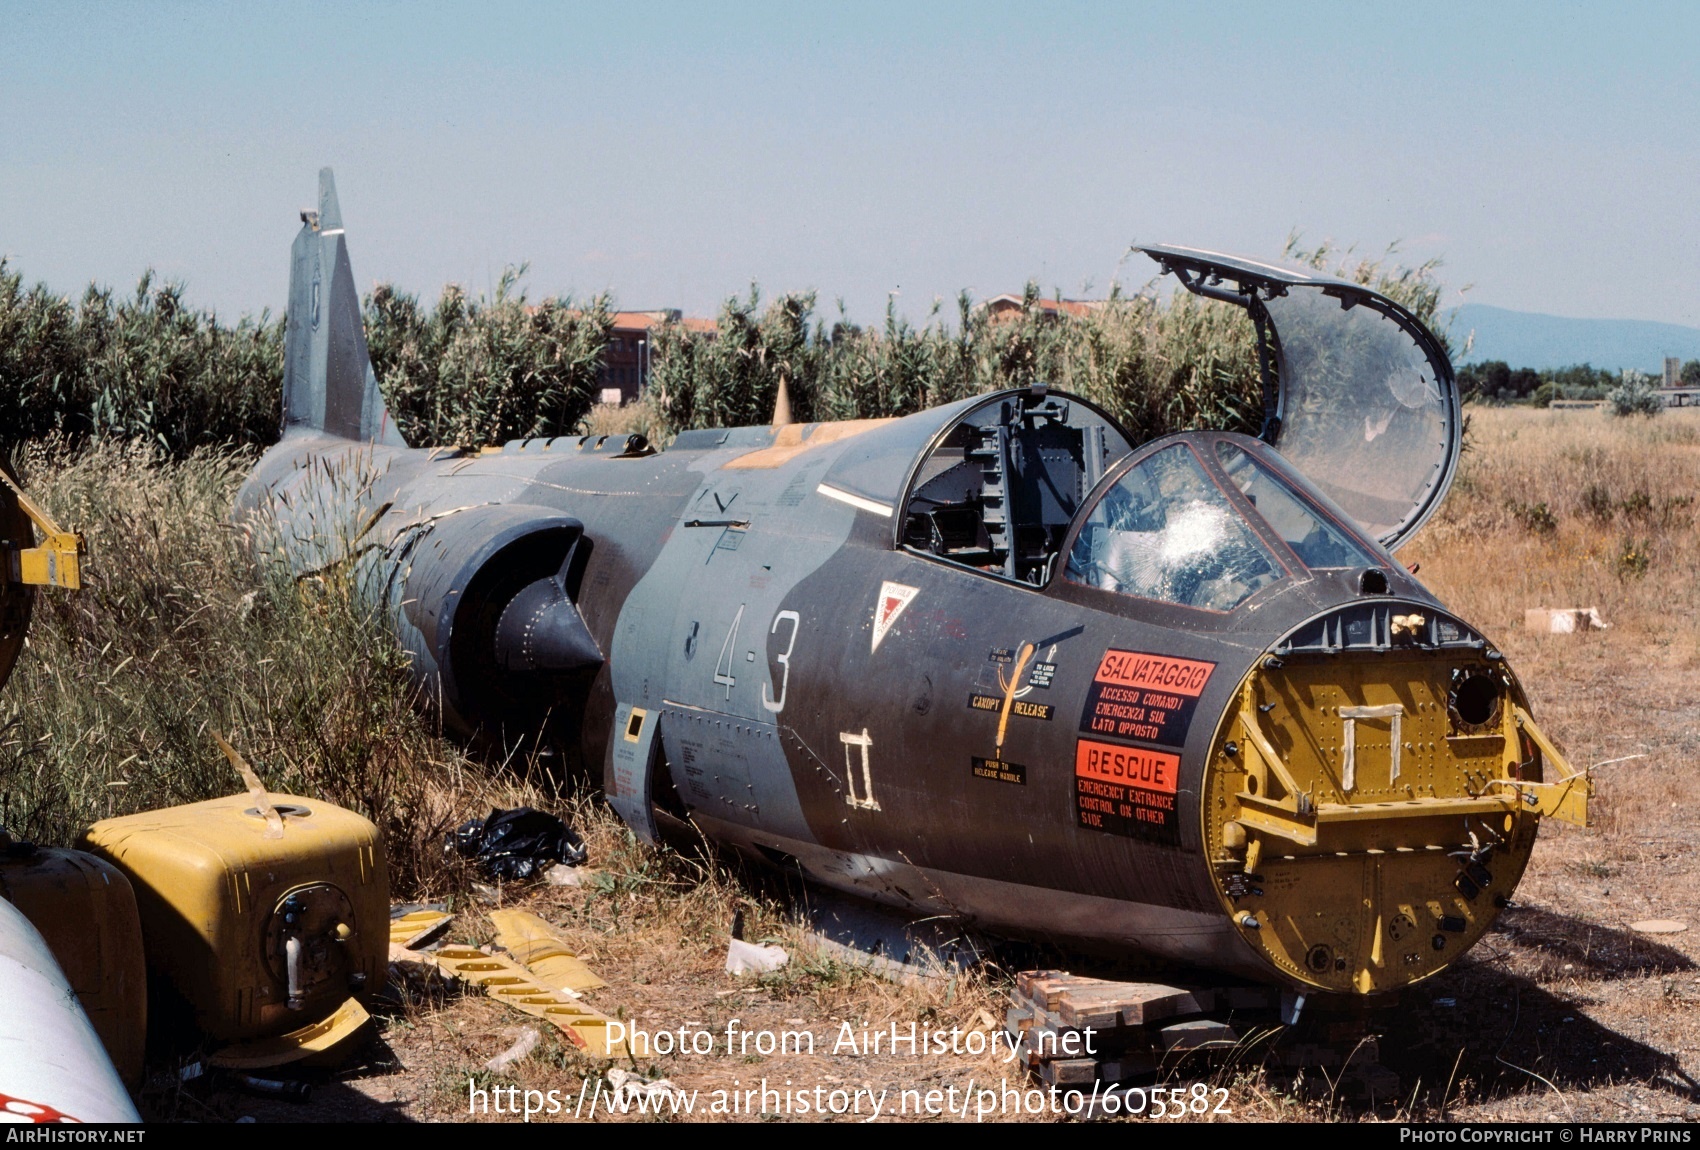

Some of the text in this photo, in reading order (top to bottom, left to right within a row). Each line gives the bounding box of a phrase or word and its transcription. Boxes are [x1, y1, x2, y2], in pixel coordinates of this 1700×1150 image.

[1101, 655, 1207, 690] SALVATAGGIO
[972, 696, 1049, 718] CANOPY RELEASE
[1100, 686, 1184, 710] ACCESSO COMANDI
[1095, 702, 1166, 724] EMERGENZA SUL
[1092, 717, 1158, 739] LATO OPPOSTO
[974, 768, 998, 778] RELEASE
[985, 760, 999, 769] PUSH
[1087, 749, 1166, 785] RESCUE
[1078, 780, 1174, 810] EMERGENCY ENTRANCE
[1080, 796, 1165, 825] CONTROL ON OTHER
[1081, 812, 1103, 827] SIDE
